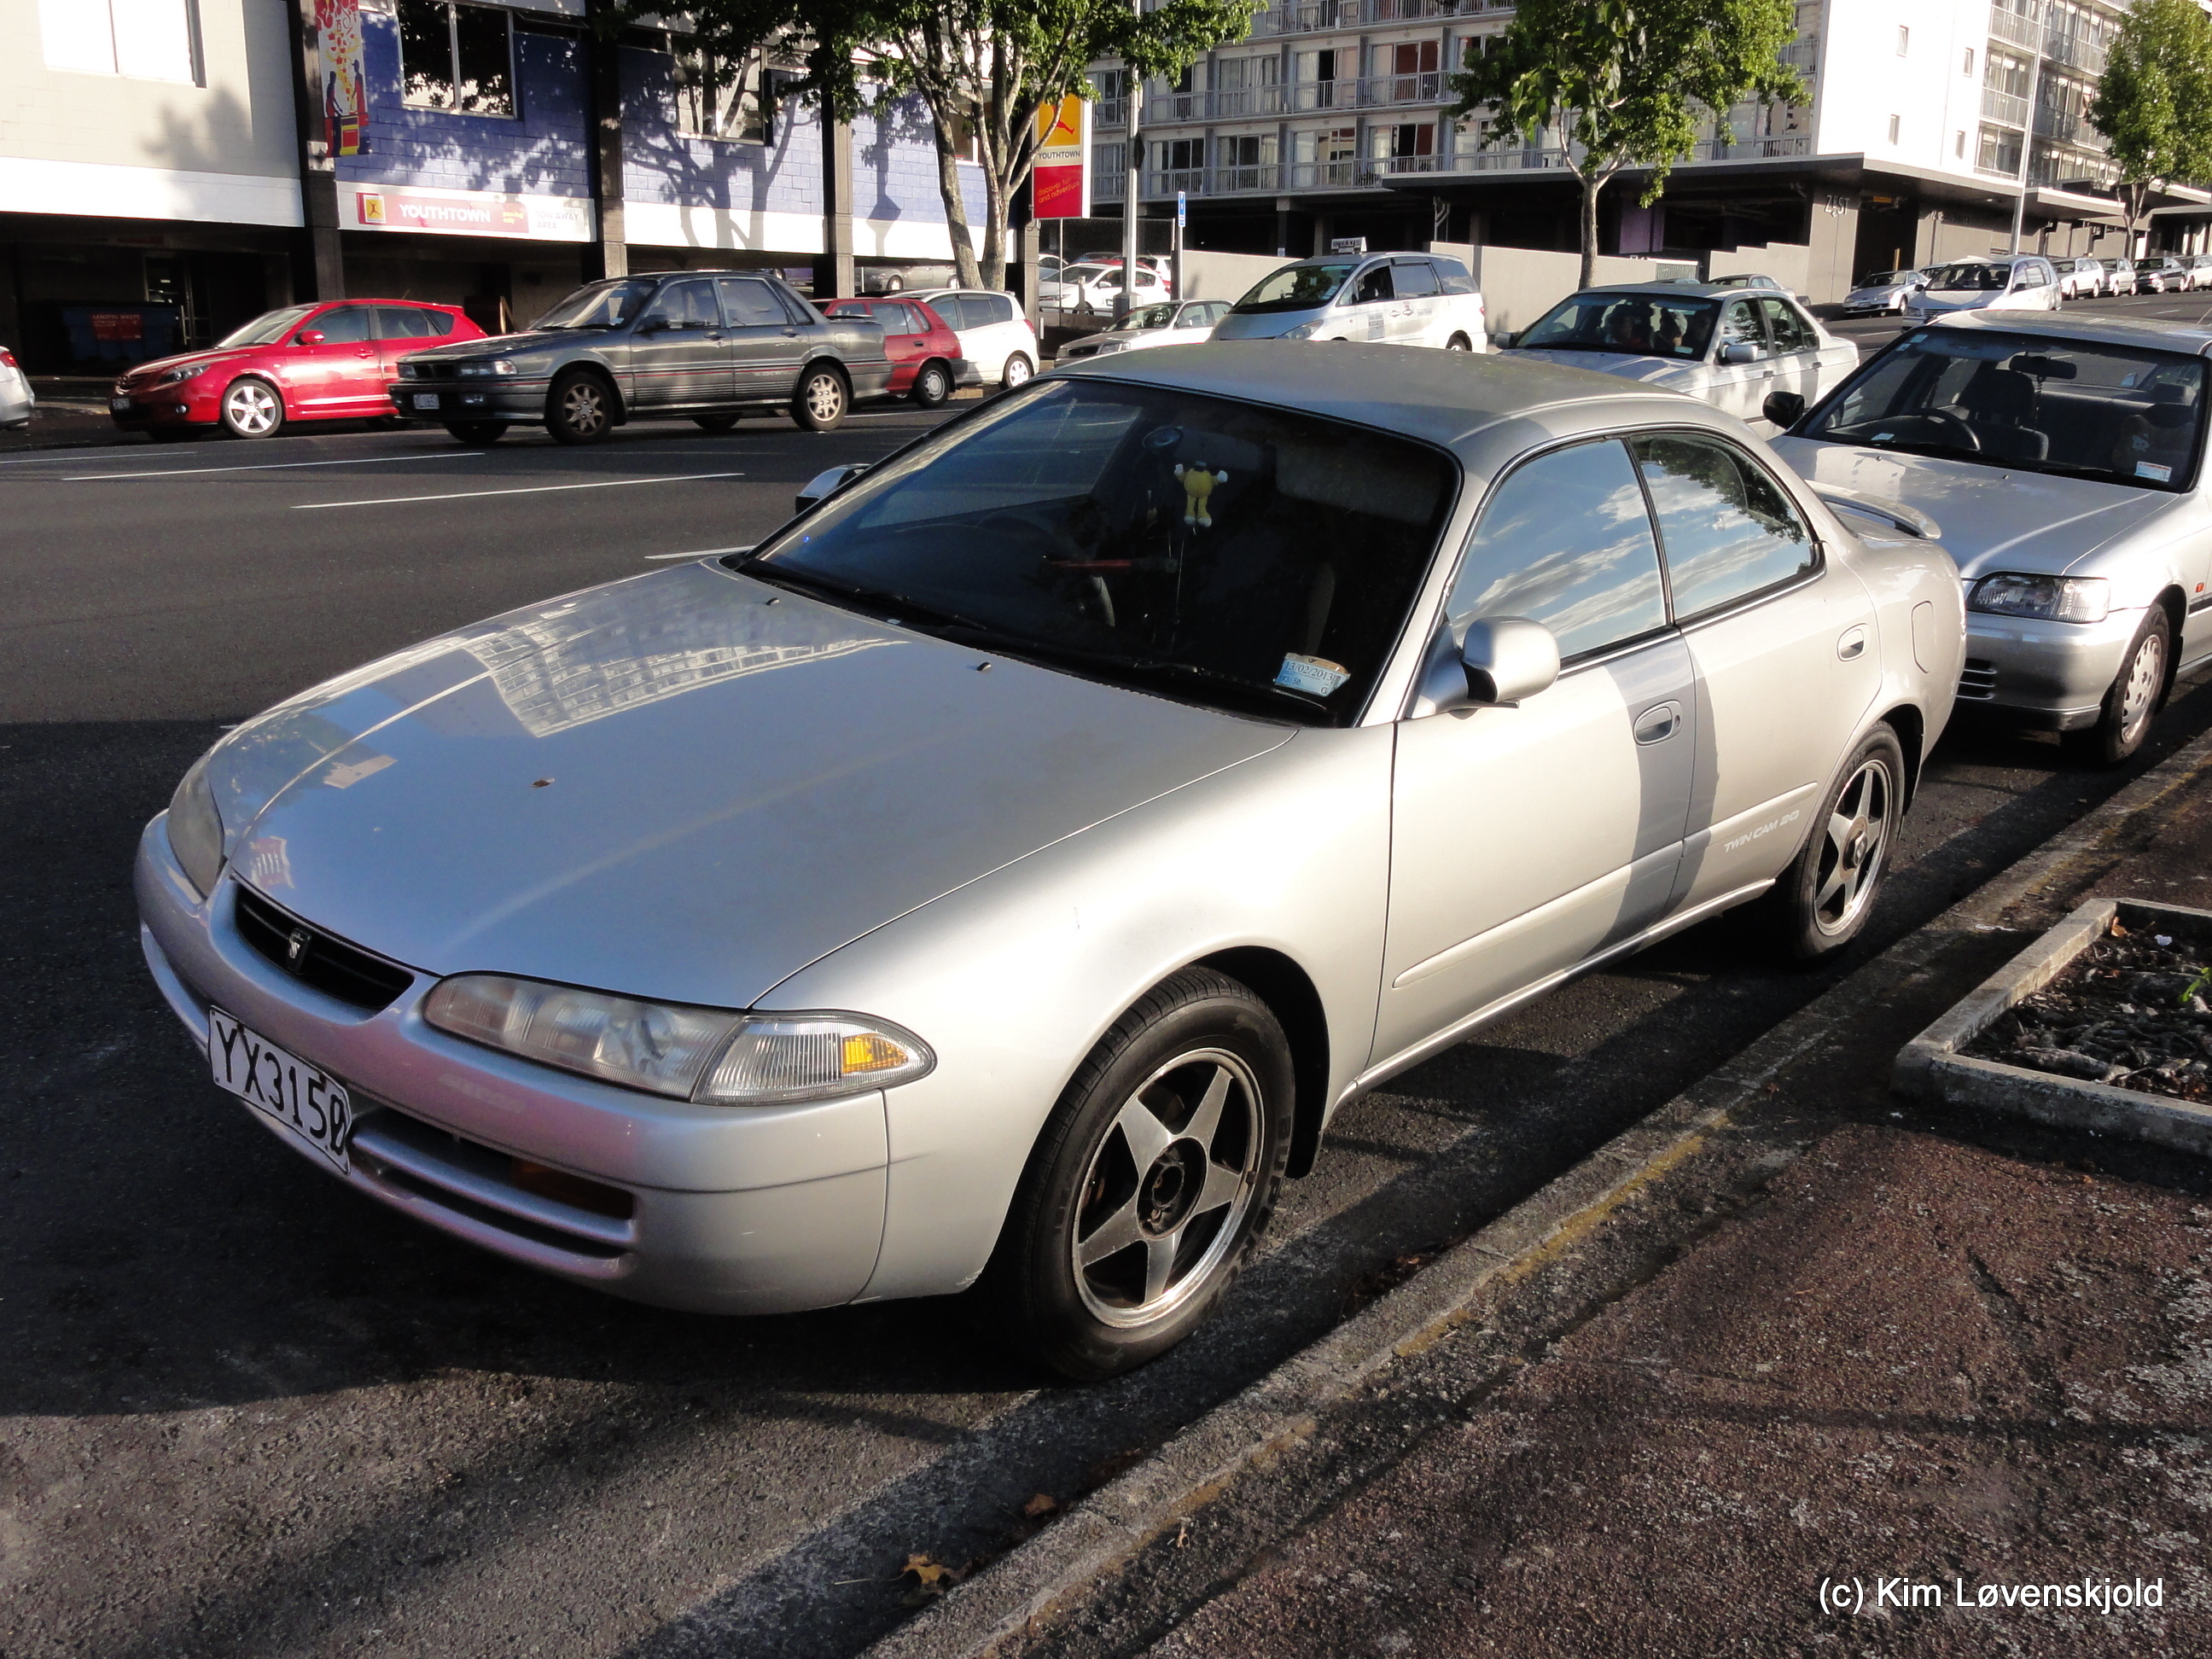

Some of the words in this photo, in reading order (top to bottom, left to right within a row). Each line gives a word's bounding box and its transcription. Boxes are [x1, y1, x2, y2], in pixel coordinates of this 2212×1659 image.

[1039, 150, 1080, 160] YOUTHTOWN
[1037, 183, 1061, 196] discover
[1039, 194, 1051, 203] and
[1051, 181, 1080, 198] adventure
[399, 204, 492, 223] YOUTHTOWN
[536, 211, 553, 219] TOW
[556, 212, 579, 221] AWAY
[1824, 195, 1850, 217] ZEST
[1284, 661, 1334, 682] 13/02/2013
[1320, 686, 1329, 695] G
[1724, 831, 1753, 853] TWIN
[1753, 819, 1778, 839] CAM
[1779, 809, 1800, 826] 20
[216, 1020, 346, 1156] YX3150
